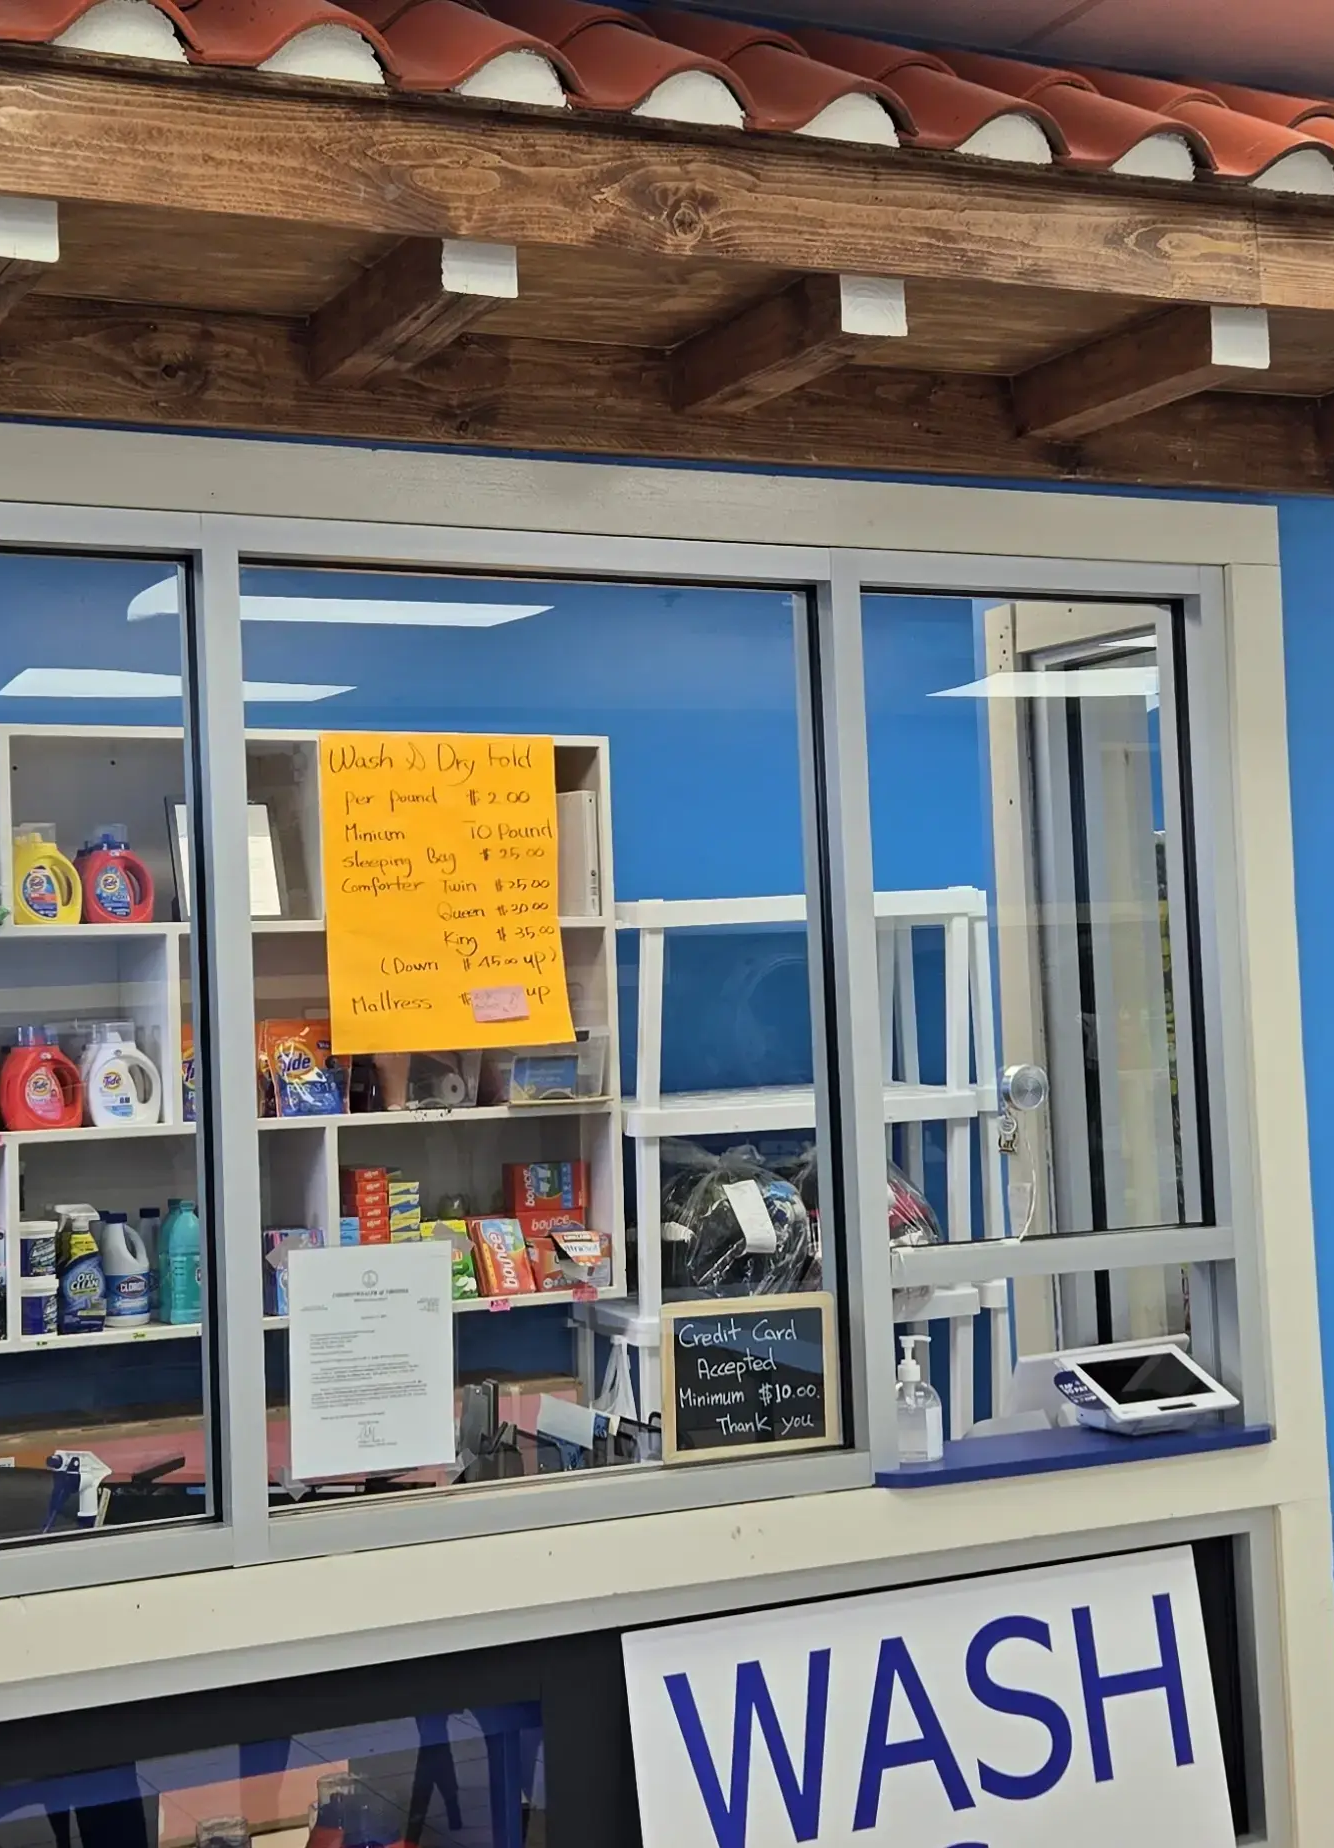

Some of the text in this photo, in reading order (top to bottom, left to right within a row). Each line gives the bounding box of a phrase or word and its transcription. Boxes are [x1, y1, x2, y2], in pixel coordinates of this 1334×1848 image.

[329, 743, 393, 773] Wash
[437, 742, 475, 787] Dry
[487, 743, 532, 769] Fold
[344, 791, 375, 815] per
[389, 786, 438, 812] pound
[497, 817, 553, 841] Pound
[427, 848, 456, 874] Bag
[342, 876, 425, 897] Comforter
[442, 880, 478, 893] Twin
[437, 902, 485, 920] Queen
[443, 929, 478, 957] King
[381, 957, 439, 976] (Down
[526, 986, 551, 1005] up
[32, 1080, 53, 1093] Tide
[103, 1074, 122, 1089] Tide
[524, 1164, 536, 1208] bounce
[530, 1214, 570, 1231] bounce
[487, 1231, 519, 1289] bounce
[678, 1318, 797, 1348] Credit Card
[697, 1347, 777, 1382] Accepted
[679, 1387, 745, 1408] Minimum
[716, 1412, 814, 1436] Thank you
[663, 1592, 1195, 1848] WASH
